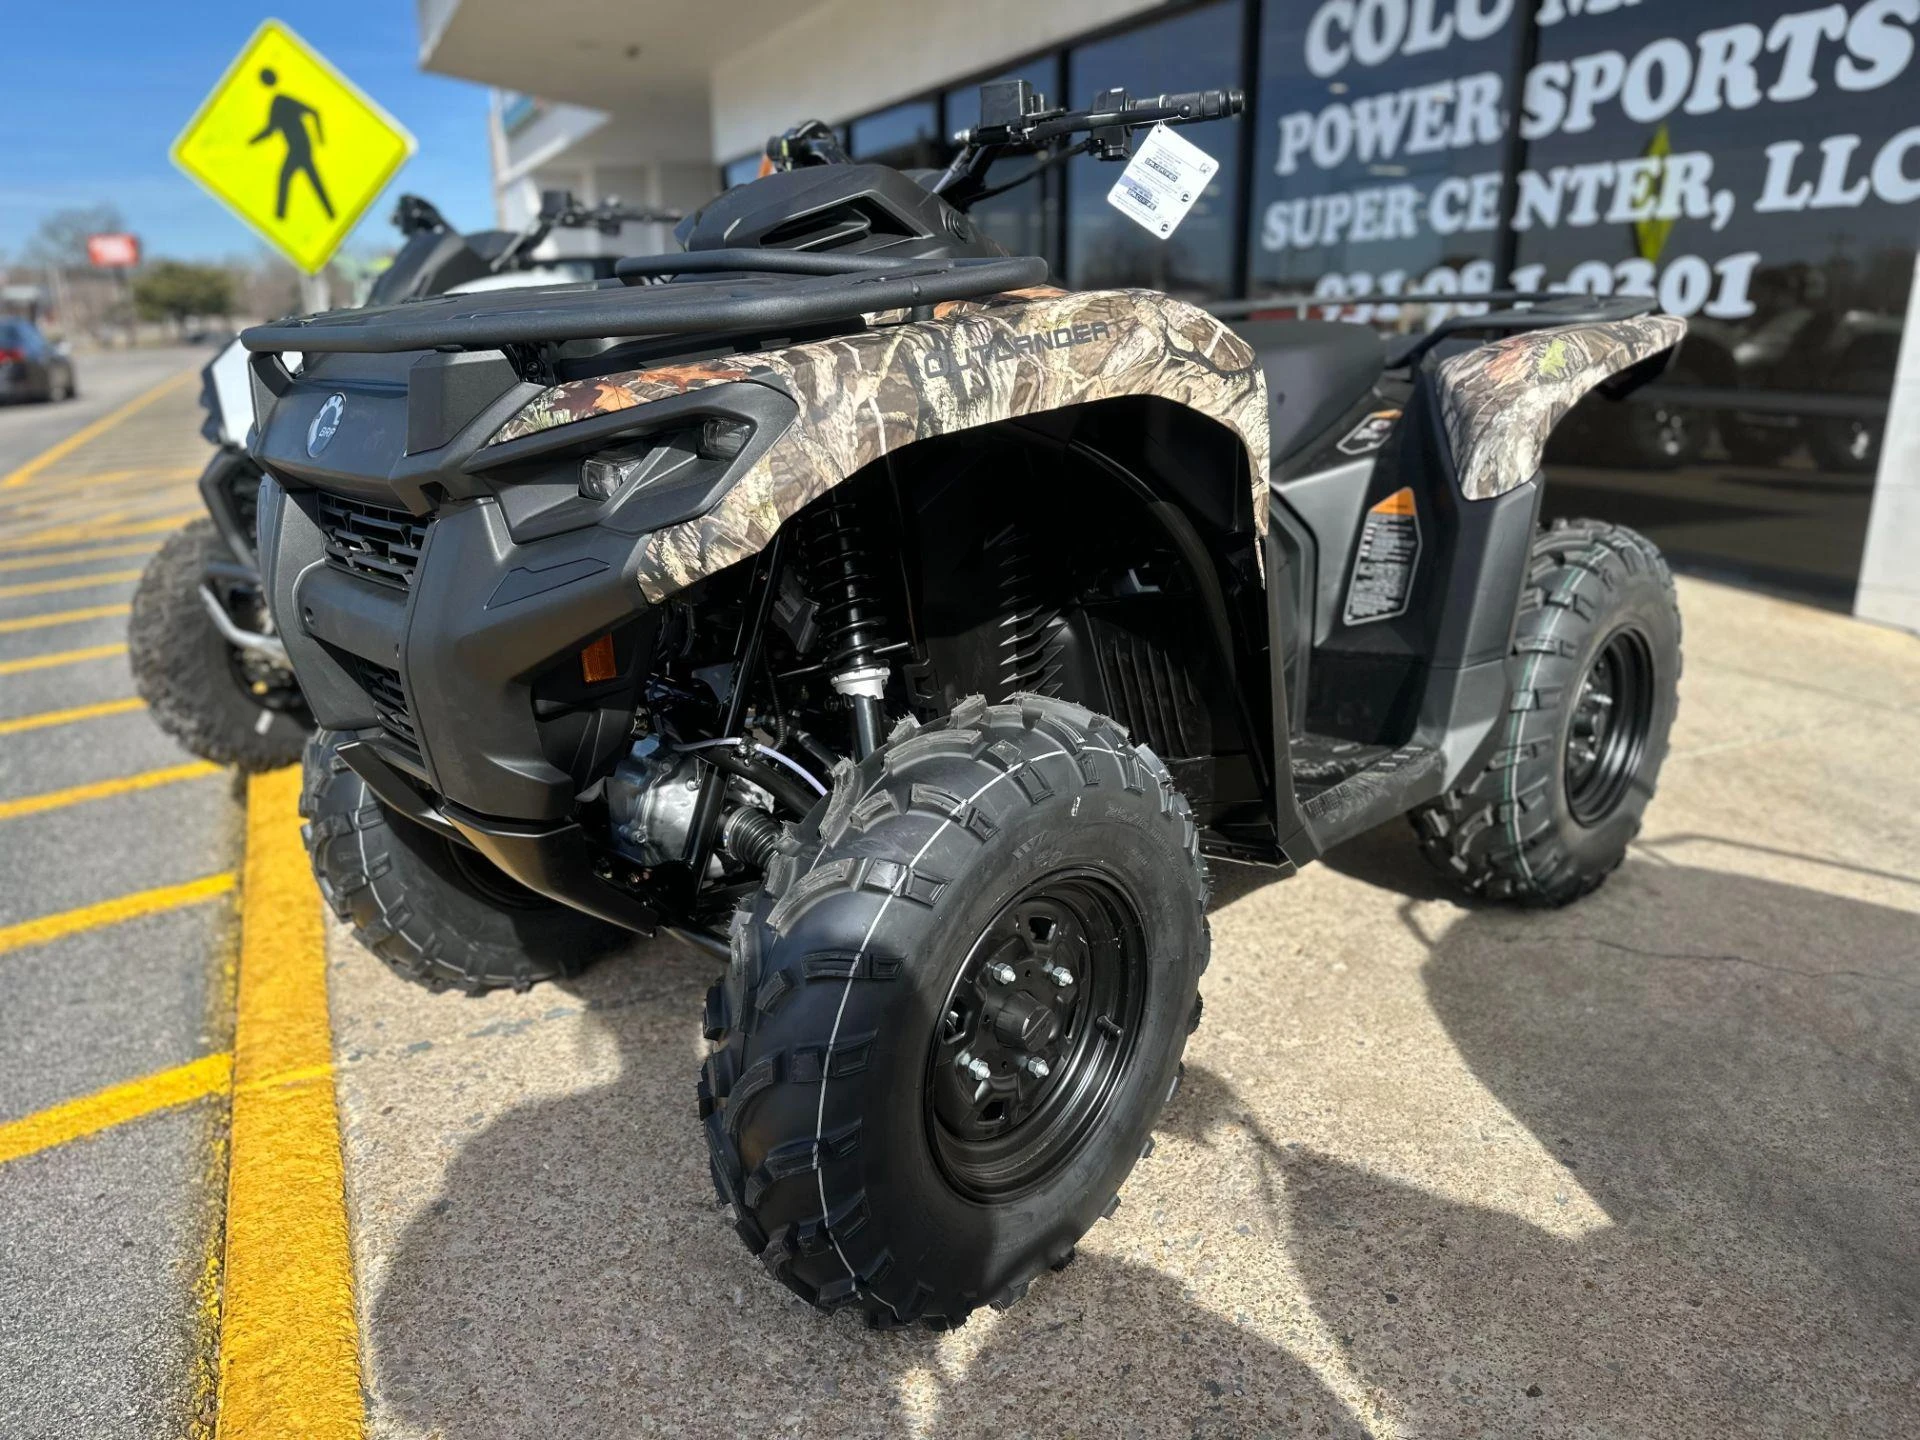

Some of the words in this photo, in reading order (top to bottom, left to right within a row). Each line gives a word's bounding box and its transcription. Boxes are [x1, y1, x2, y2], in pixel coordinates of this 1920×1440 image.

[1275, 72, 1509, 175] POWER
[1520, 0, 1919, 138] SPORTS
[1263, 187, 1418, 252] SUPER
[1428, 151, 1735, 233] CENTER,
[1754, 125, 1920, 212] LLC
[923, 321, 1111, 379] OUTLANDER
[318, 426, 337, 438] BRP
